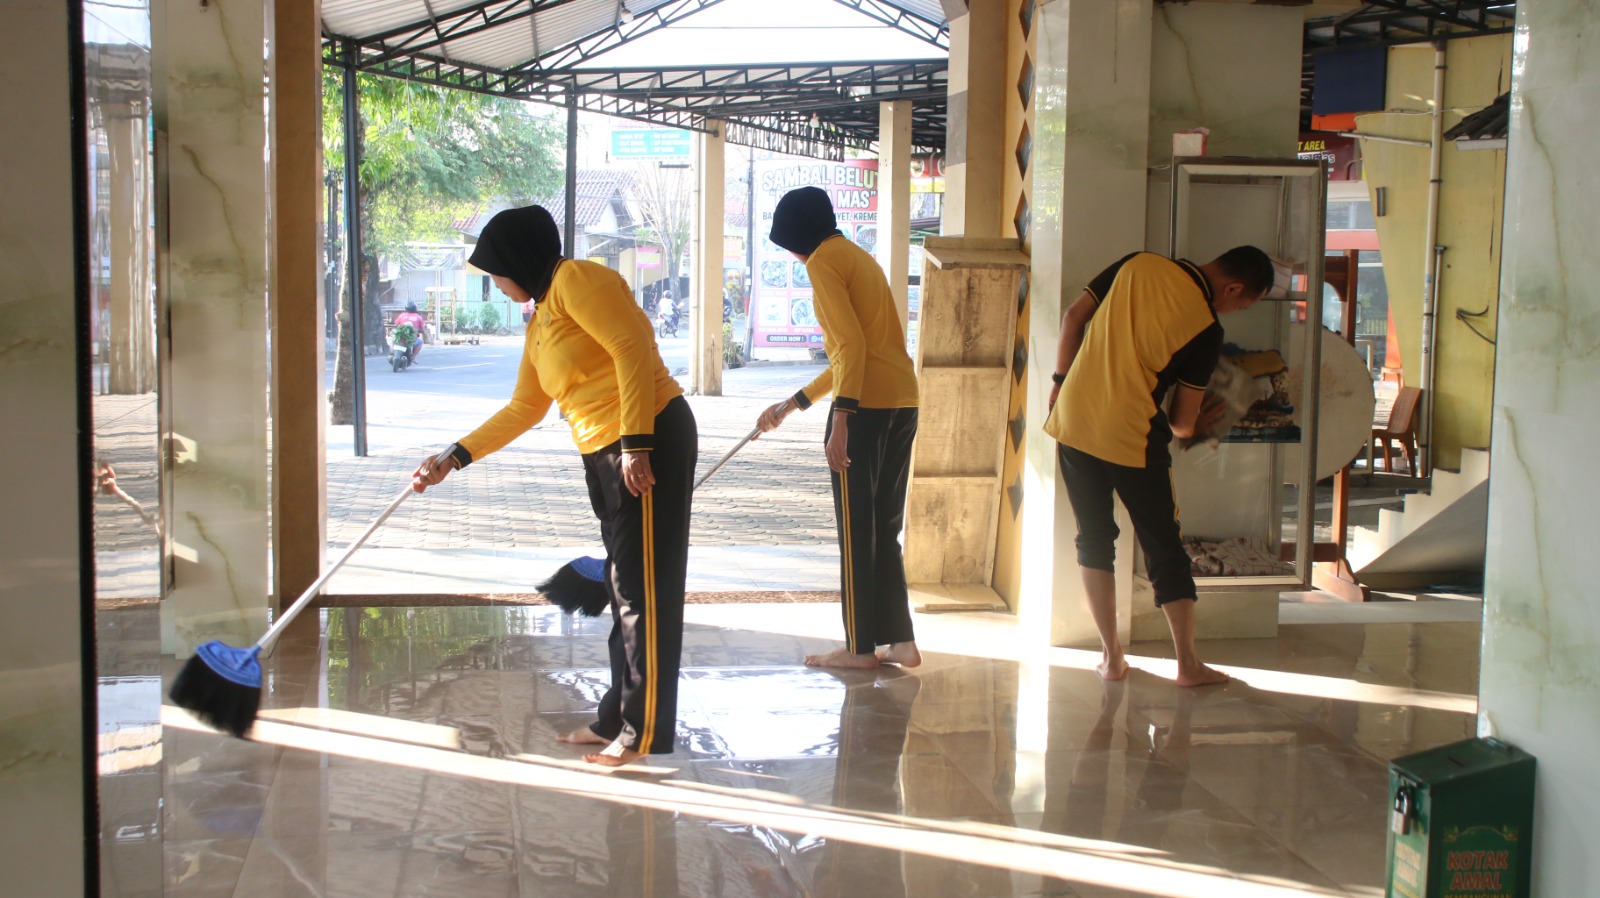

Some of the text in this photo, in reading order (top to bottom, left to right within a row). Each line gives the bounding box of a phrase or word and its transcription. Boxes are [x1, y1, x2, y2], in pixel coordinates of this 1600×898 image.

[1304, 140, 1325, 150] AREA
[762, 164, 831, 191] SAMBAL
[1447, 850, 1509, 870] KOTAK
[1450, 871, 1502, 891] AMAL
